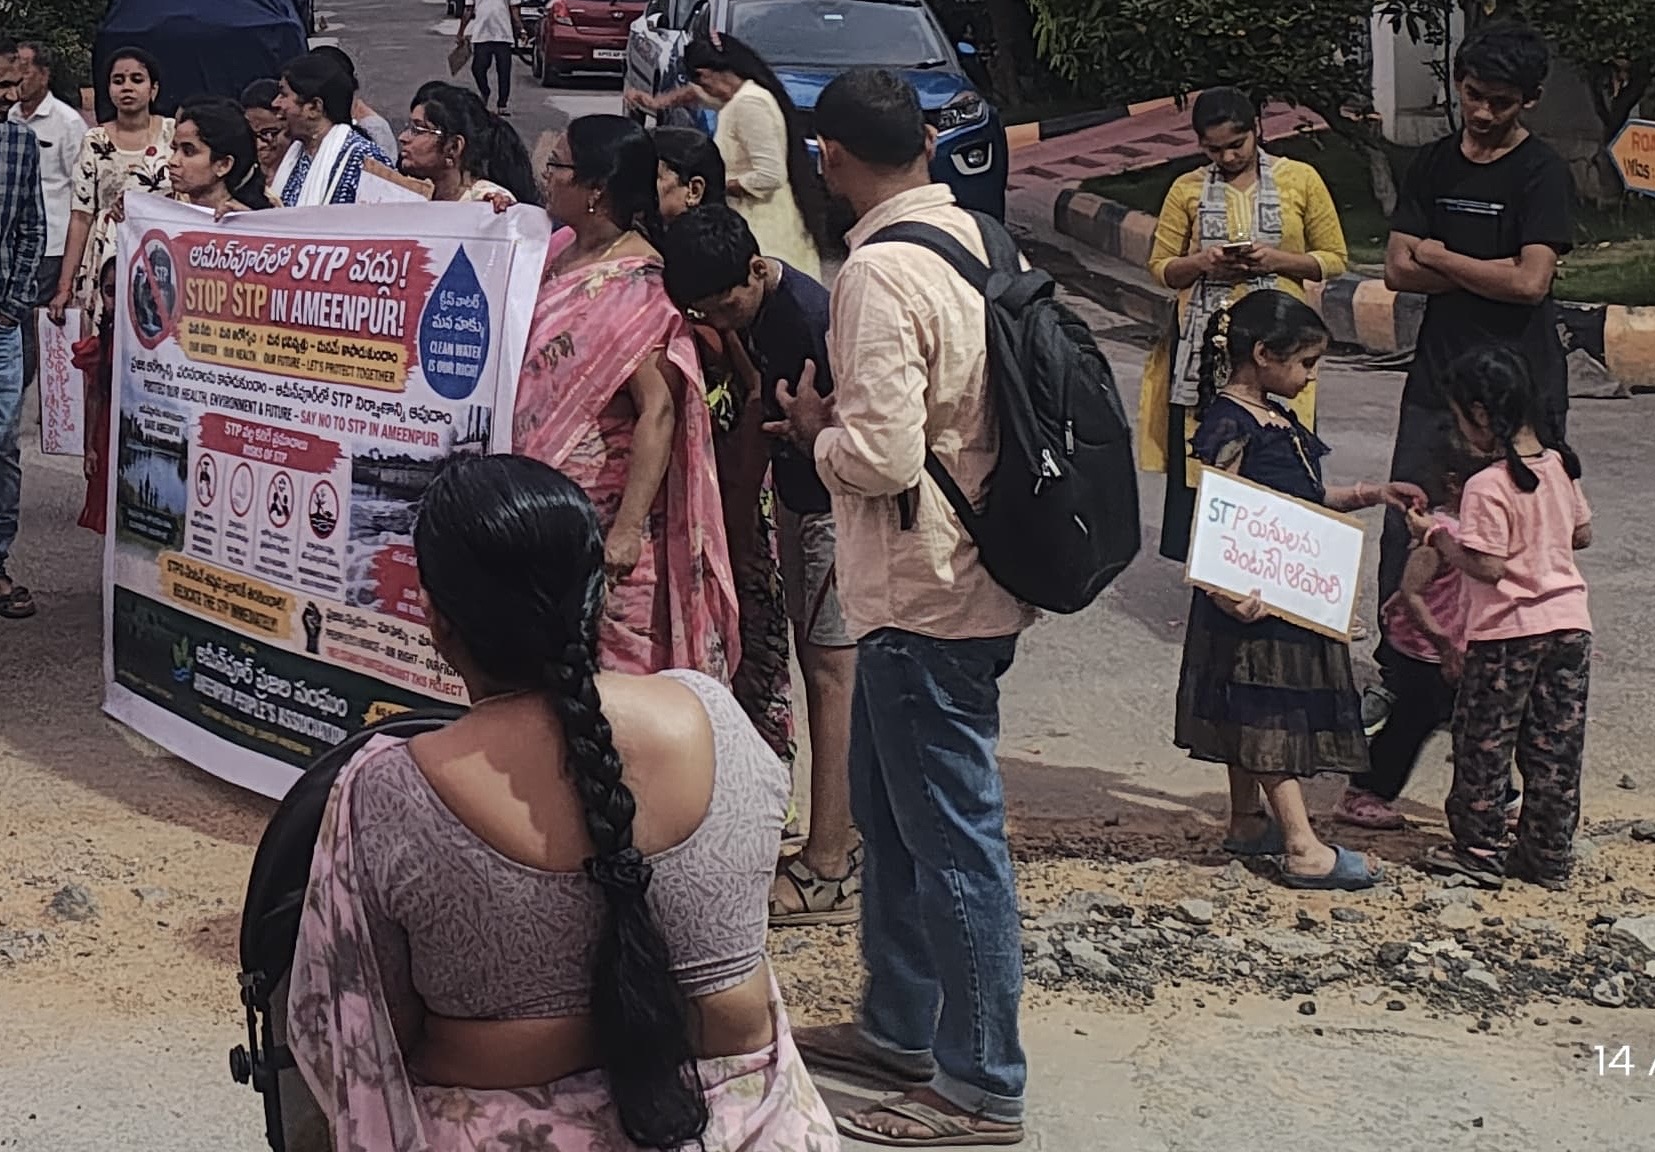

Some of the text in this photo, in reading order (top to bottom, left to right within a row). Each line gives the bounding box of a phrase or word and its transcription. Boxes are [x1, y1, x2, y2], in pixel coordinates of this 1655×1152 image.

[291, 244, 350, 282] STP
[185, 277, 406, 337] STOP STP IN AMEENPUR!
[430, 341, 481, 359] CLEAN WATER
[428, 359, 436, 372] IS
[437, 360, 455, 375] OUR
[331, 390, 354, 409] STP
[224, 421, 242, 436] STP
[300, 409, 317, 426] SAY
[318, 413, 332, 429] NO
[333, 416, 345, 432] TO
[347, 418, 367, 436] STP
[368, 422, 379, 437] IN
[381, 424, 440, 448] AMEENPUR
[1208, 497, 1248, 530] STP
[440, 662, 462, 678] FIG
